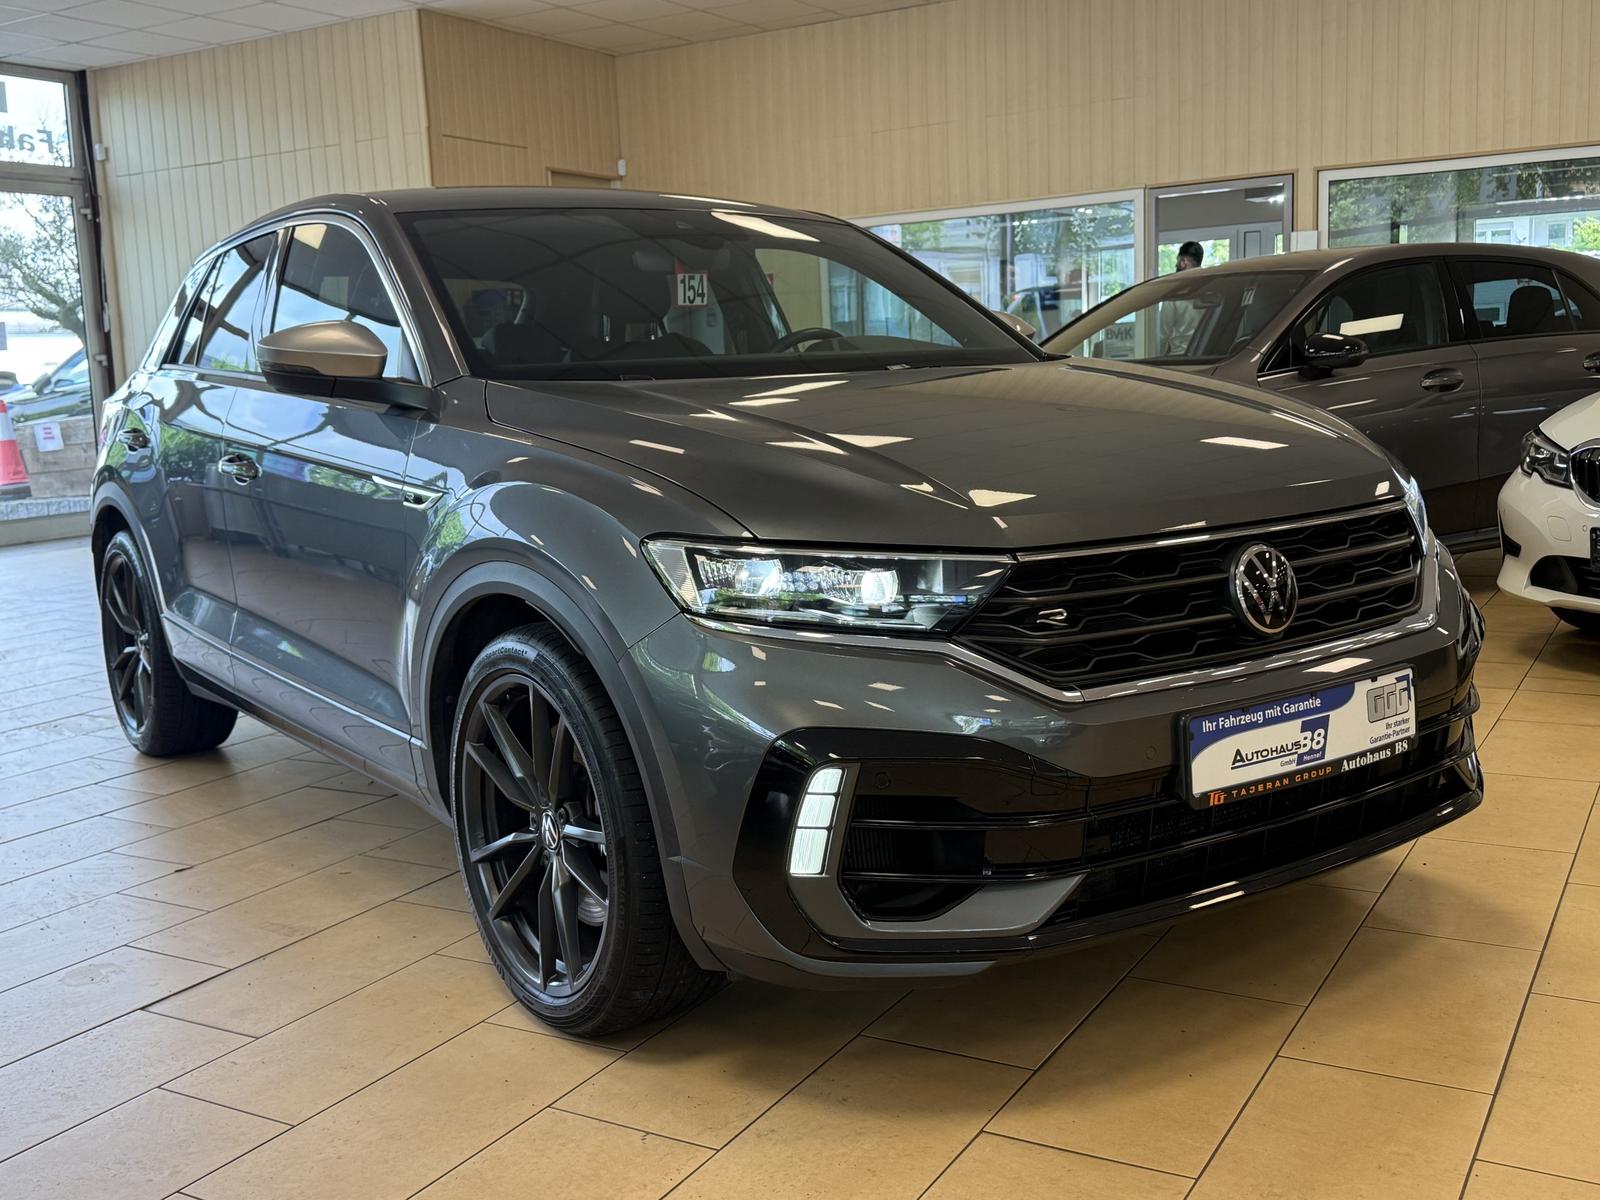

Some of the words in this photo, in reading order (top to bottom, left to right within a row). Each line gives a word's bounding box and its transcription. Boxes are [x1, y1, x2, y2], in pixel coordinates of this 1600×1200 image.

[680, 274, 705, 304] 154
[1202, 720, 1216, 733] Ihr
[1219, 711, 1264, 729] Fahrzeug
[1265, 705, 1281, 719] mit
[1282, 697, 1321, 714] Garantie
[1298, 728, 1325, 754] B8
[1341, 748, 1392, 773] Autohaus
[1395, 739, 1409, 755] B8
[1231, 778, 1290, 799] TAJERAN
[1295, 766, 1333, 783] GROUP
